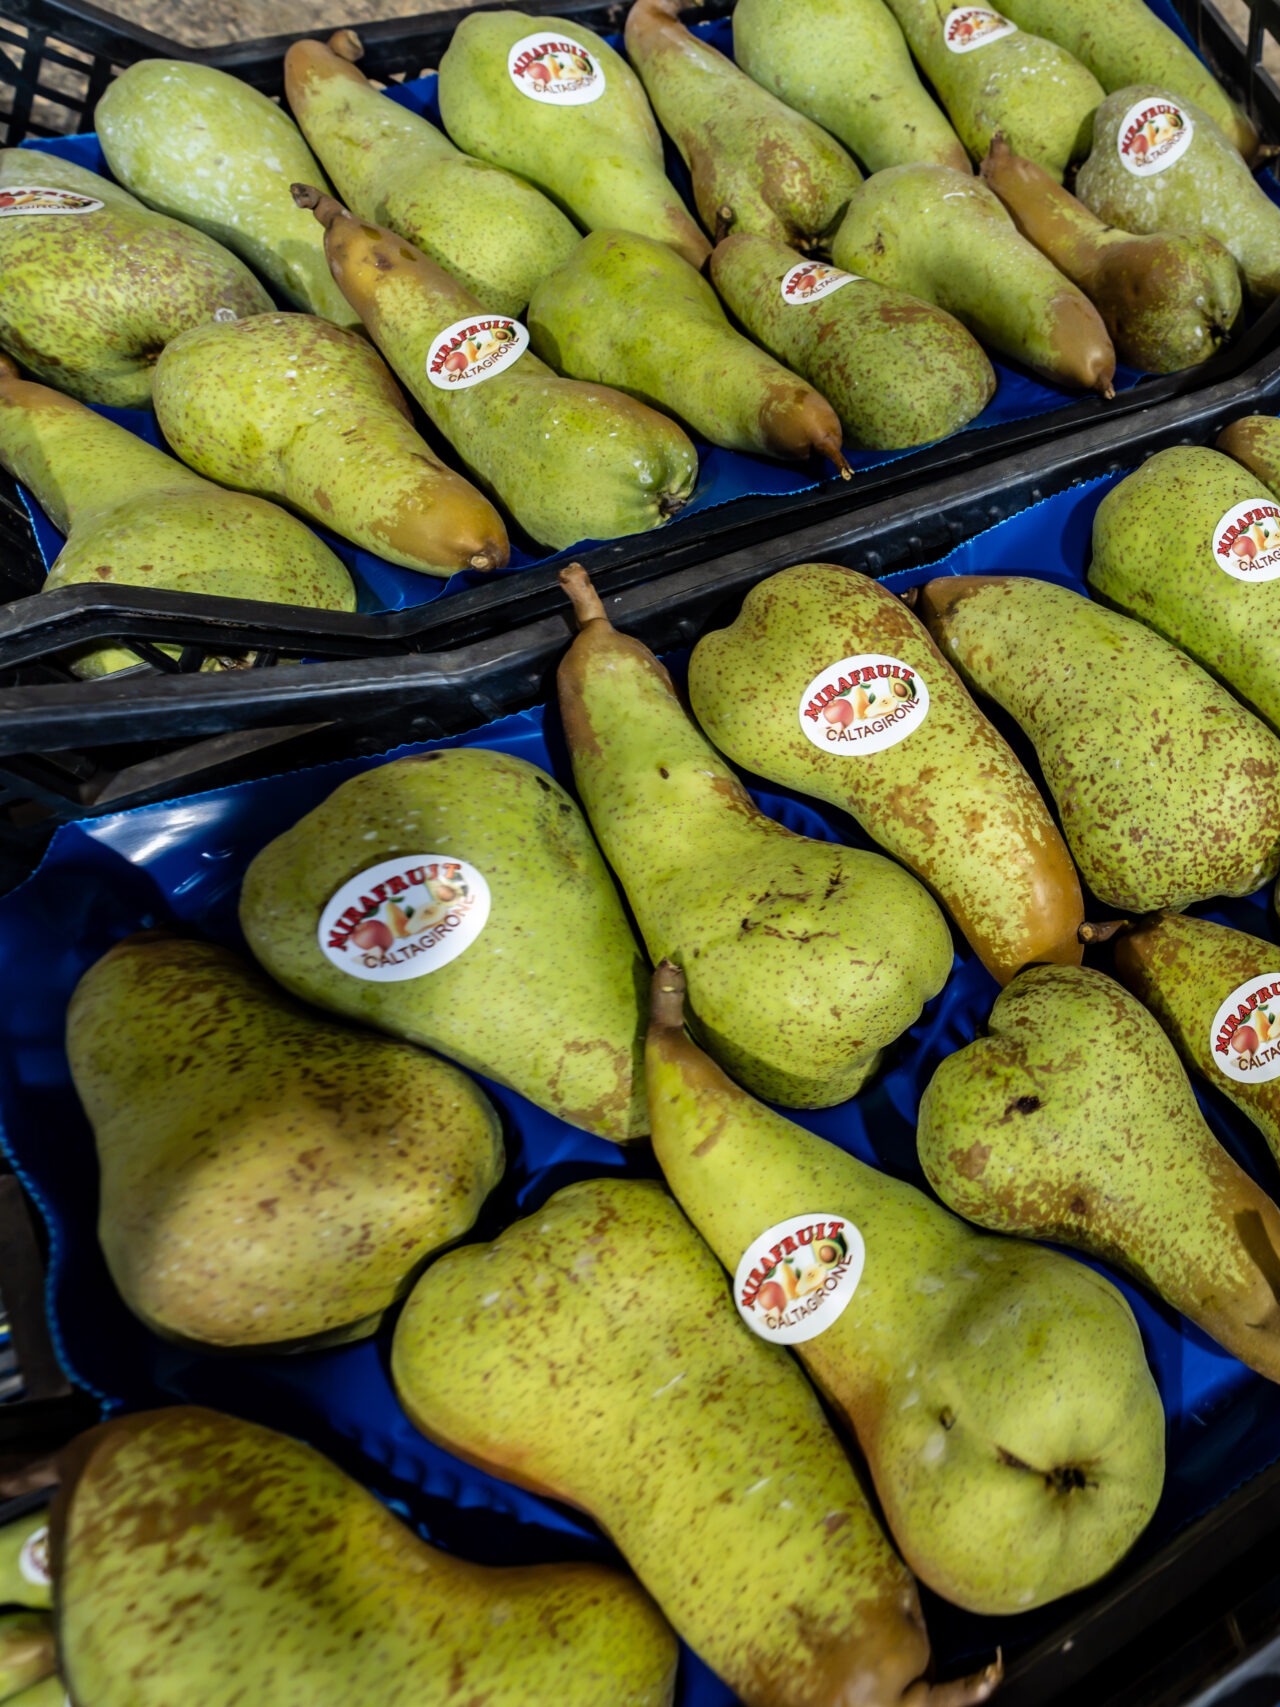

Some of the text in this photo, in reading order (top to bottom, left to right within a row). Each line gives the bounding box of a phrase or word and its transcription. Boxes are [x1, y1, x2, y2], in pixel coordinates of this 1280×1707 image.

[513, 42, 588, 78] MIRAFRUIT
[1122, 106, 1180, 155] MIRAFRUIT
[431, 320, 514, 373] MIRAFRUIT
[448, 337, 519, 383] CALTAGIRONE
[803, 664, 915, 721] MIRAFRUIT
[826, 695, 920, 742] CALTAGIRONE
[327, 863, 462, 951] MIRAFRUIT
[362, 894, 475, 969] CALTAGIRONE
[741, 1222, 845, 1311] MIRAFRUIT
[765, 1254, 853, 1332] CALTAGIRONE
